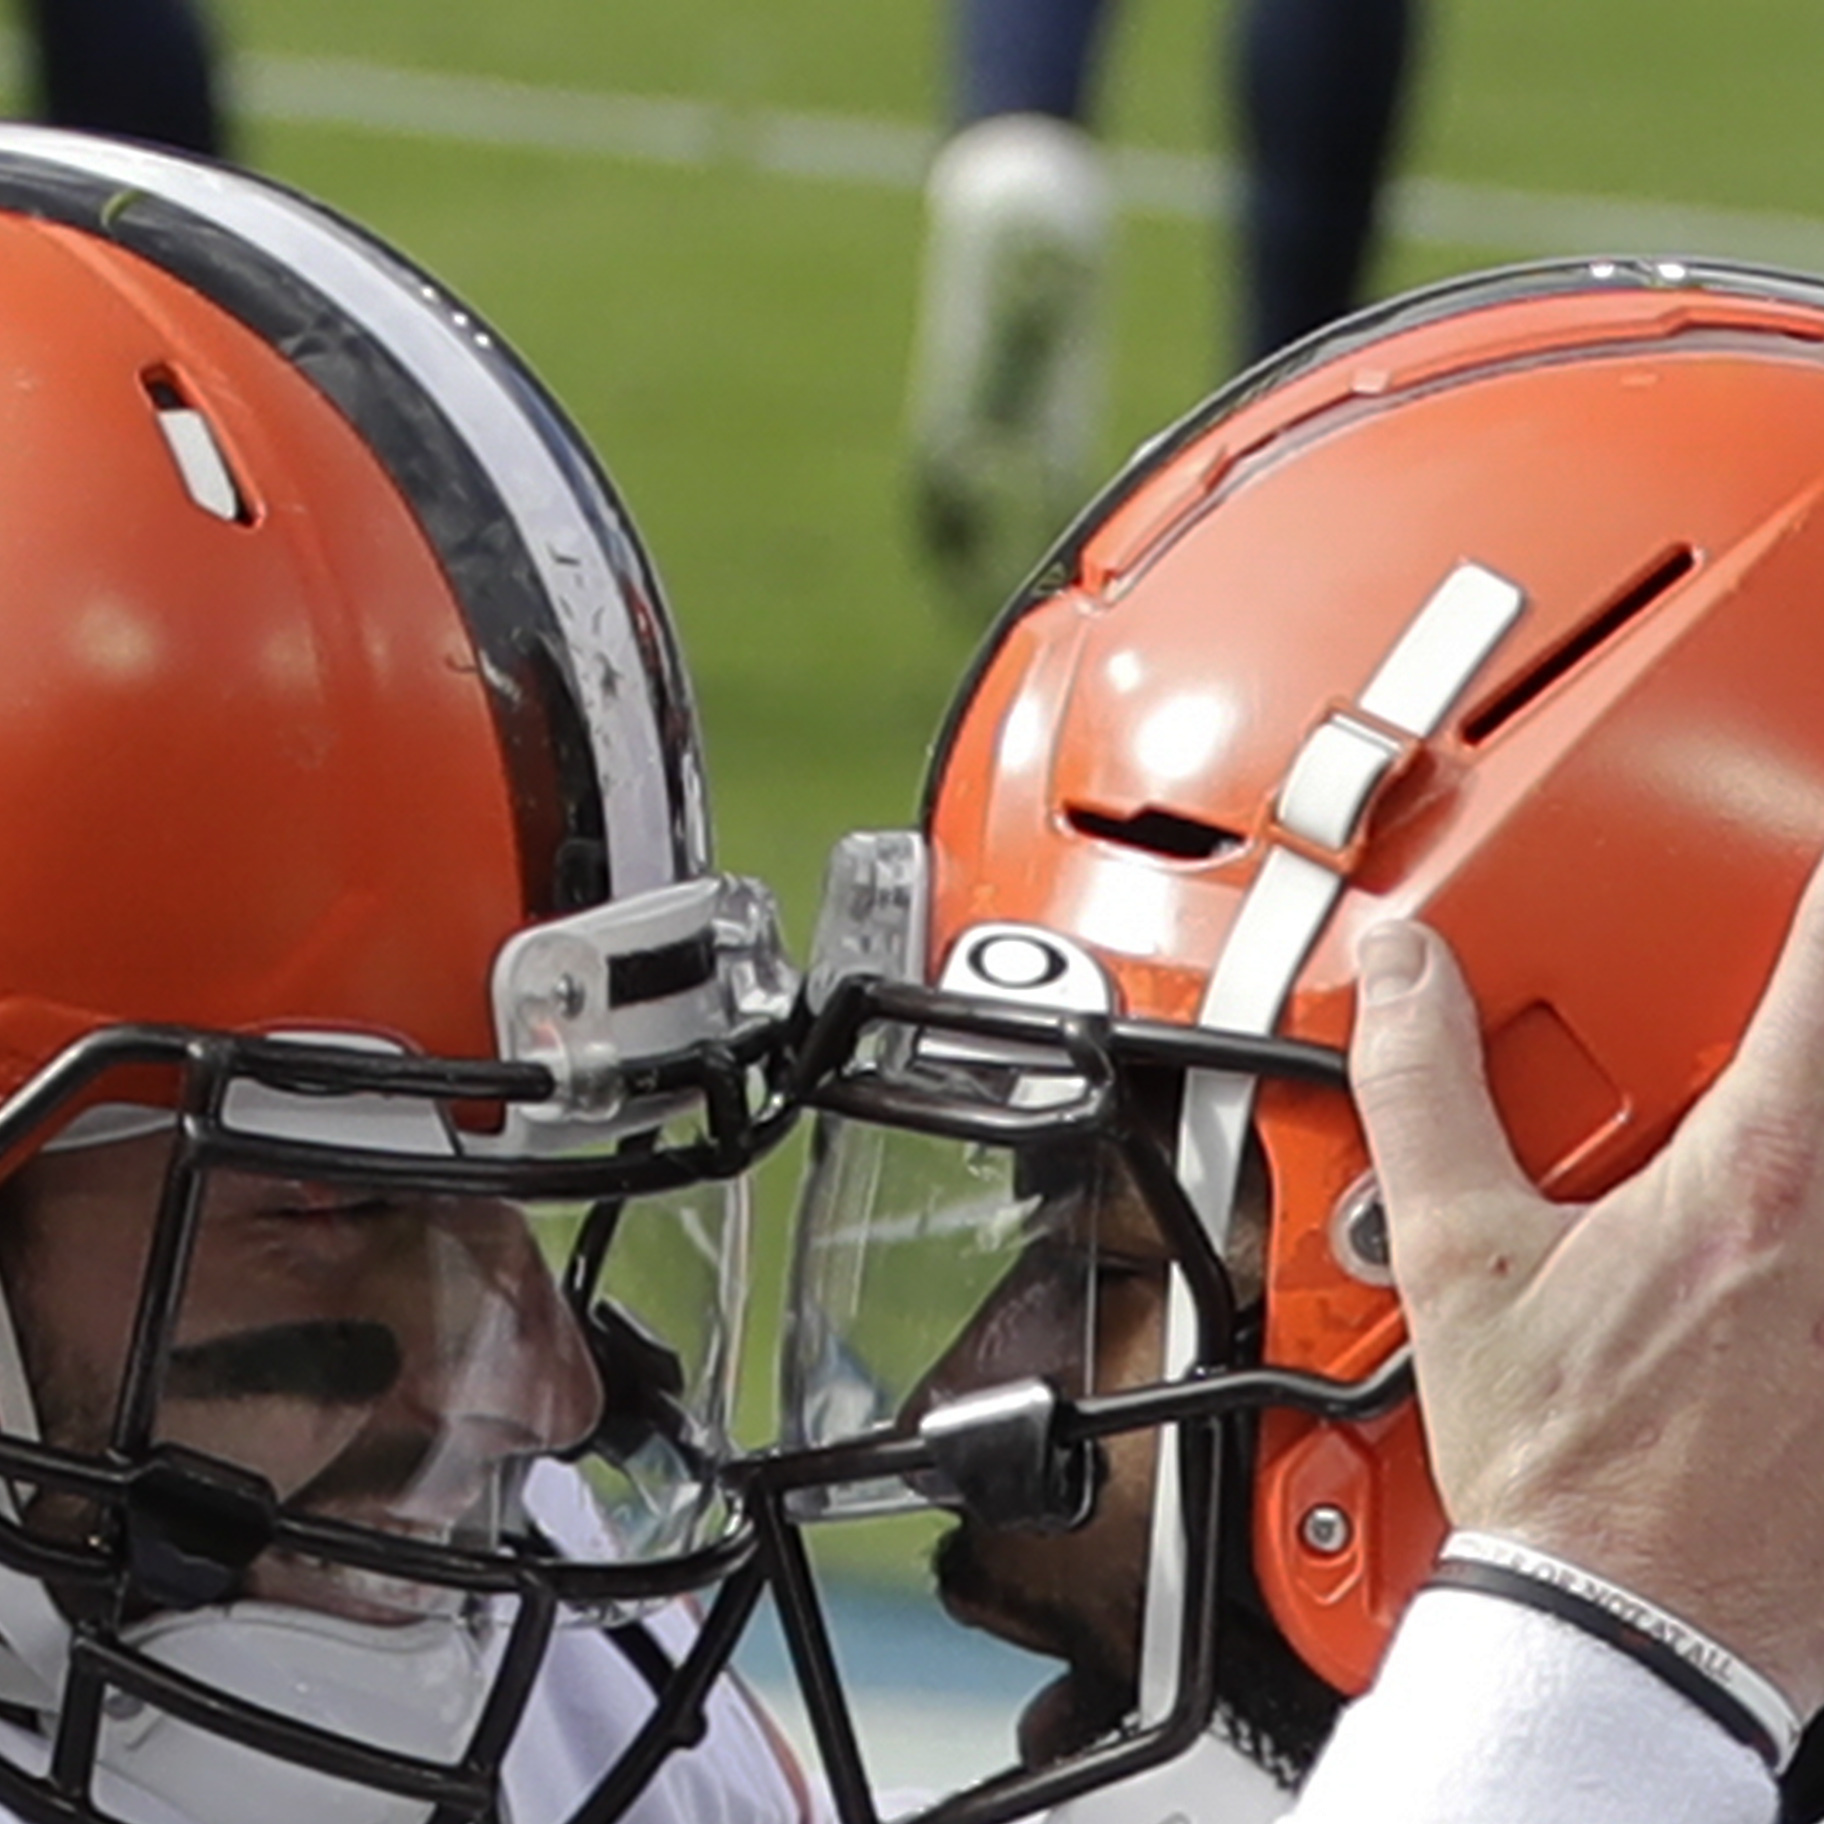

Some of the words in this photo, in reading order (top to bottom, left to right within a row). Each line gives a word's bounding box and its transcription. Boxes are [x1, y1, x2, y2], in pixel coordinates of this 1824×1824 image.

[1586, 1583, 1648, 1624] NOT
[1651, 1614, 1687, 1644] AT
[1685, 1641, 1735, 1681] ALL
